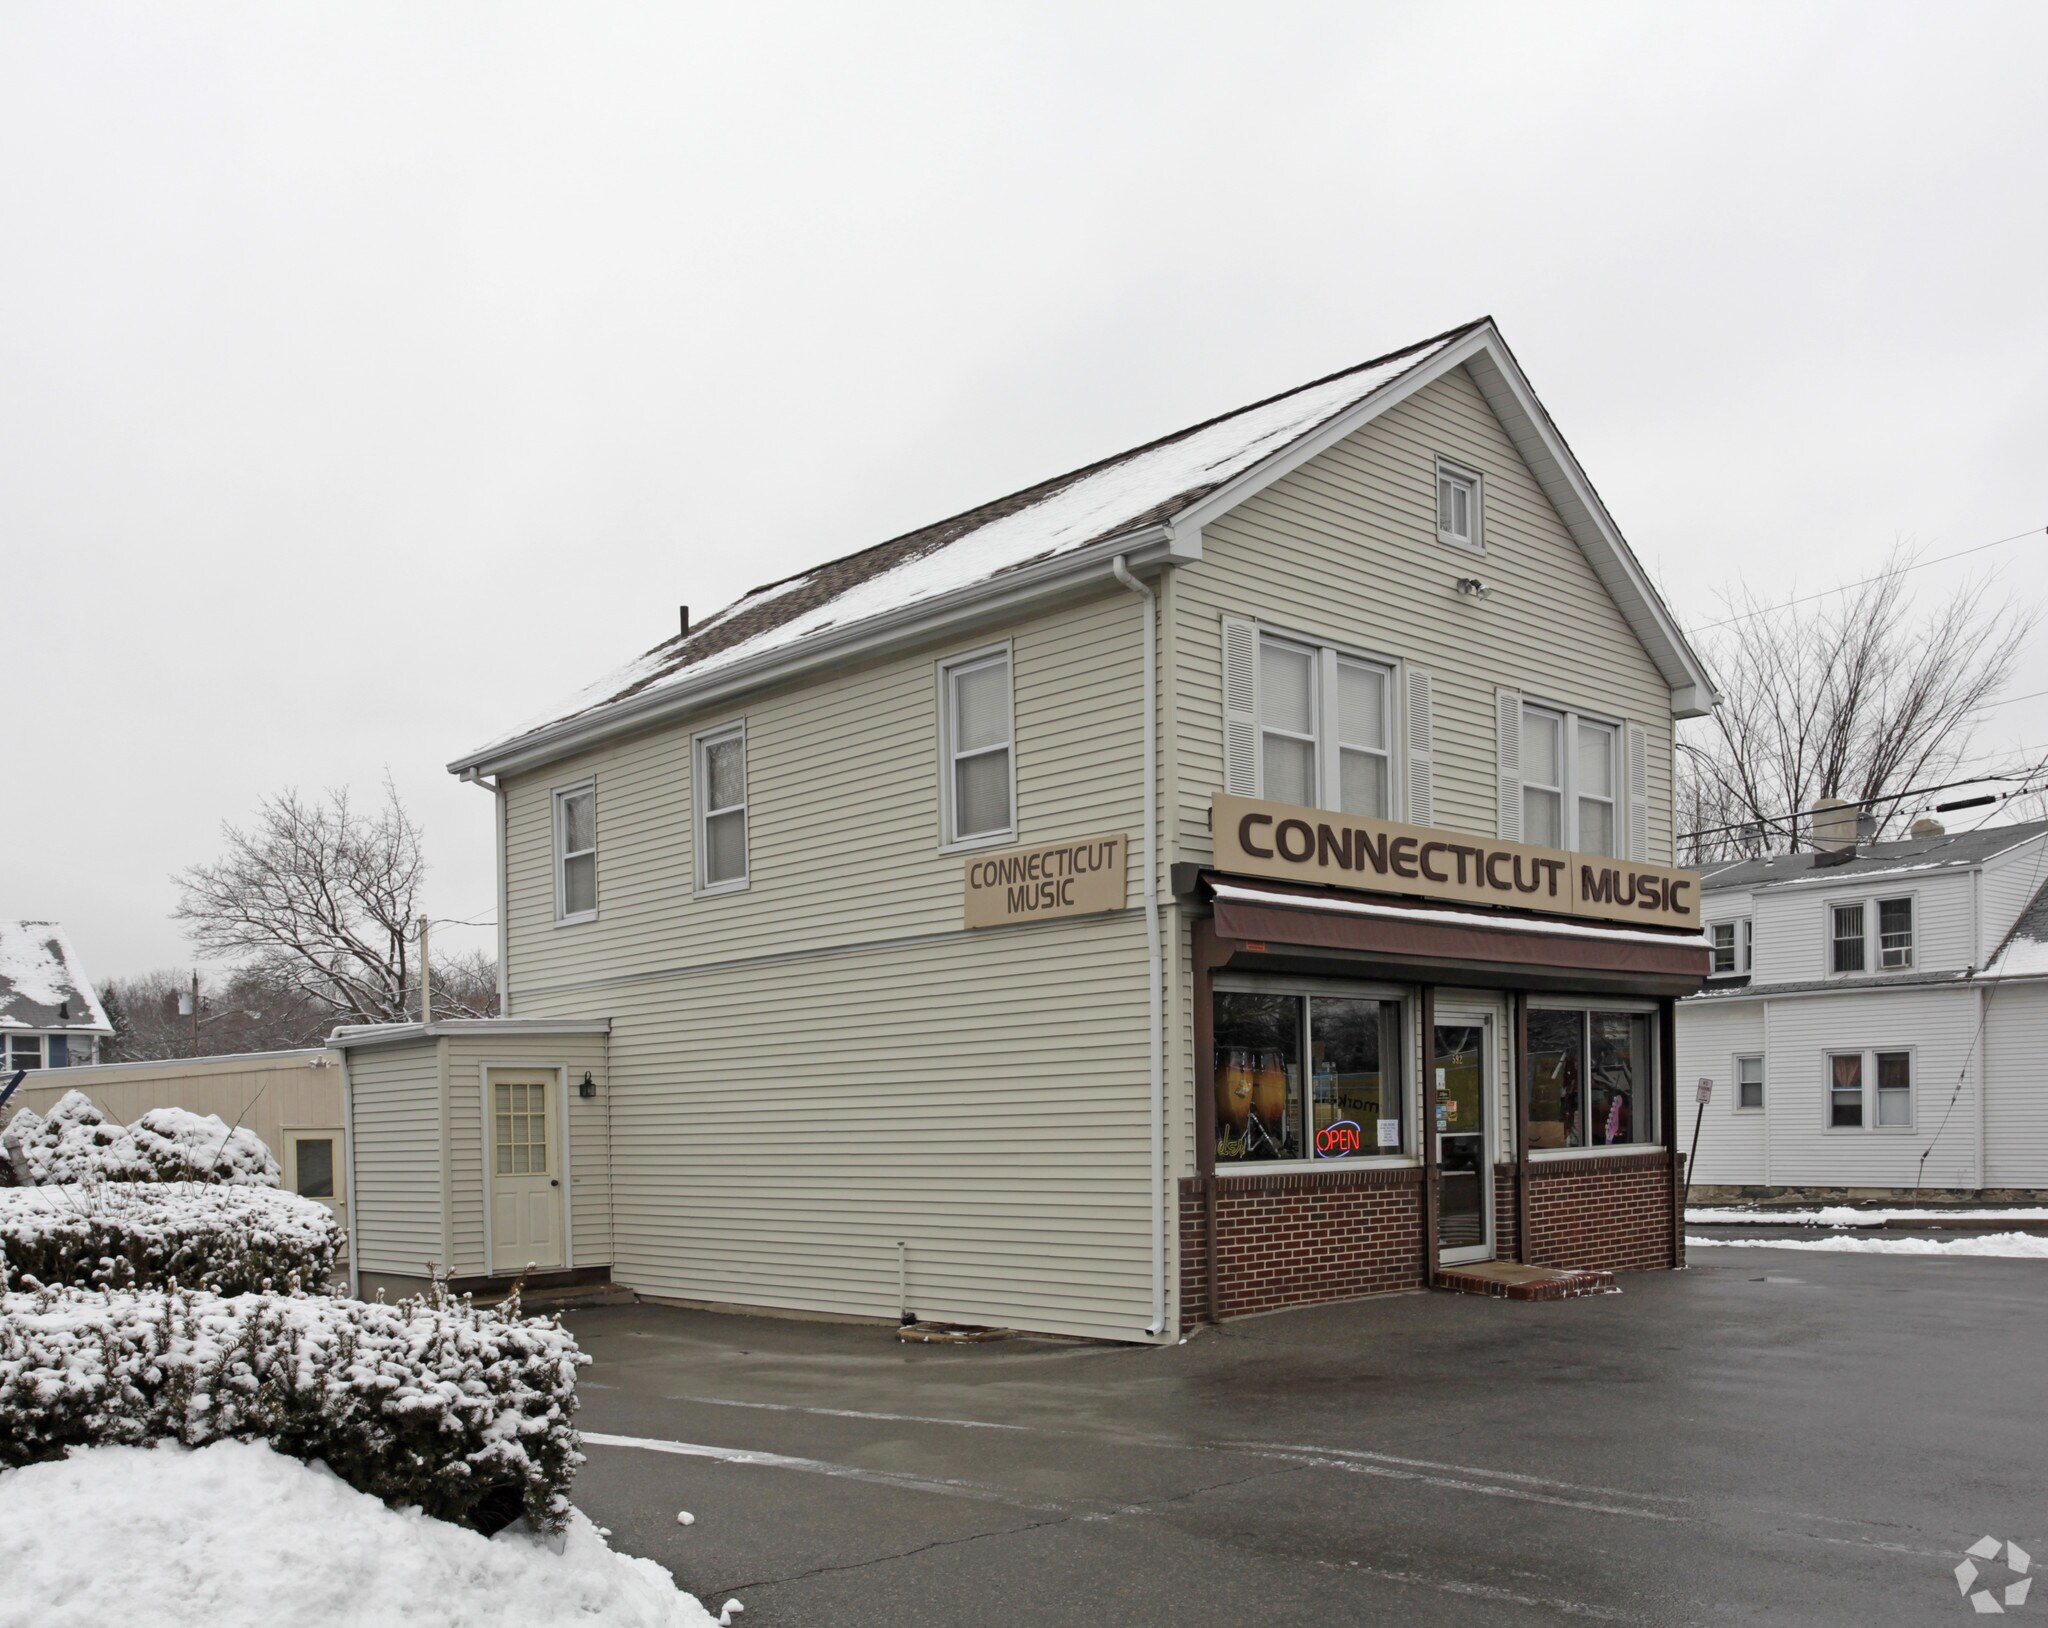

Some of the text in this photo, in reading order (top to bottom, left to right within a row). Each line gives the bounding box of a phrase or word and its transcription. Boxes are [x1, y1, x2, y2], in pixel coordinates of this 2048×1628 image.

[970, 840, 1118, 889] CONNECTICUT
[1239, 813, 1690, 914] CONNECTICUT MUSIC
[1007, 878, 1075, 914] MUSIC
[1316, 1129, 1360, 1151] OPEN
